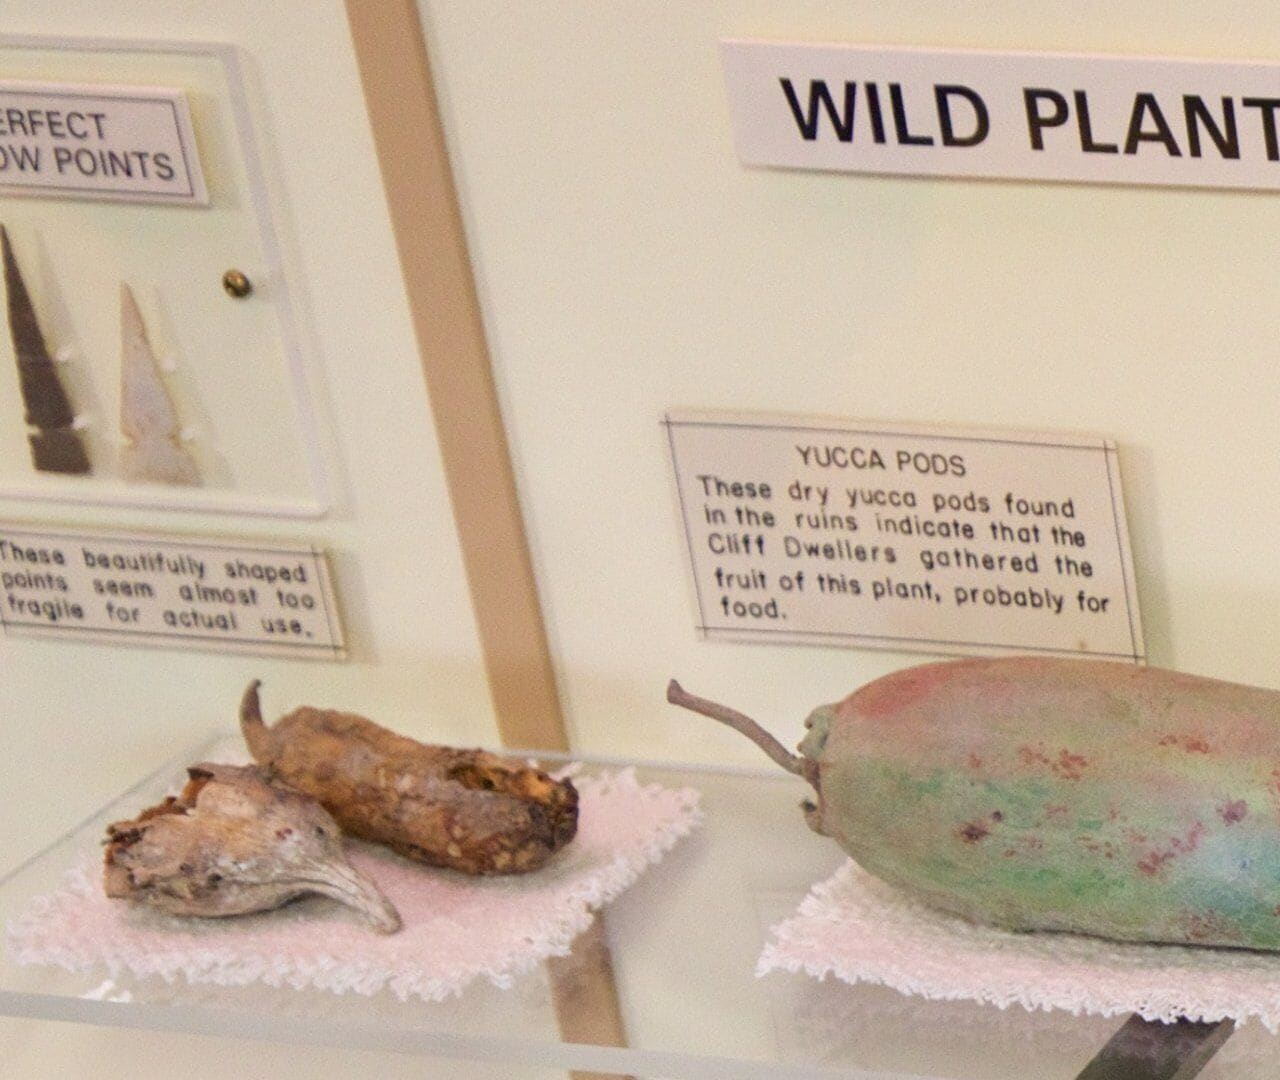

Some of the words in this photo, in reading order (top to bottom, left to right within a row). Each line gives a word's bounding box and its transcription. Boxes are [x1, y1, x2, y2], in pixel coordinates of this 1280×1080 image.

[780, 78, 990, 147] WILD
[53, 146, 175, 181] POINTS
[795, 446, 886, 470] YUCCA
[896, 450, 967, 478] PODS
[697, 474, 772, 500] These
[788, 480, 829, 507] dry
[846, 489, 917, 509] yucca
[932, 491, 991, 514] pods
[1004, 492, 1076, 519] found
[704, 505, 726, 524] in
[735, 507, 775, 528] the
[795, 513, 858, 532] ruins
[876, 516, 975, 540] indicate
[989, 522, 1040, 544] that
[1050, 526, 1086, 548] the
[0, 537, 66, 567] These
[82, 547, 204, 580] beautifully
[224, 560, 308, 584] shaped
[707, 532, 765, 555] Cliff
[783, 536, 897, 564] Dwellers
[919, 549, 1039, 574] gathered
[1054, 555, 1094, 578] the
[1, 570, 68, 593] points
[93, 577, 155, 598] seem
[178, 583, 258, 606] almost
[276, 590, 316, 610] too
[8, 594, 84, 621] fragile
[106, 602, 140, 623] for
[163, 608, 238, 631] actual
[261, 616, 312, 637] use.
